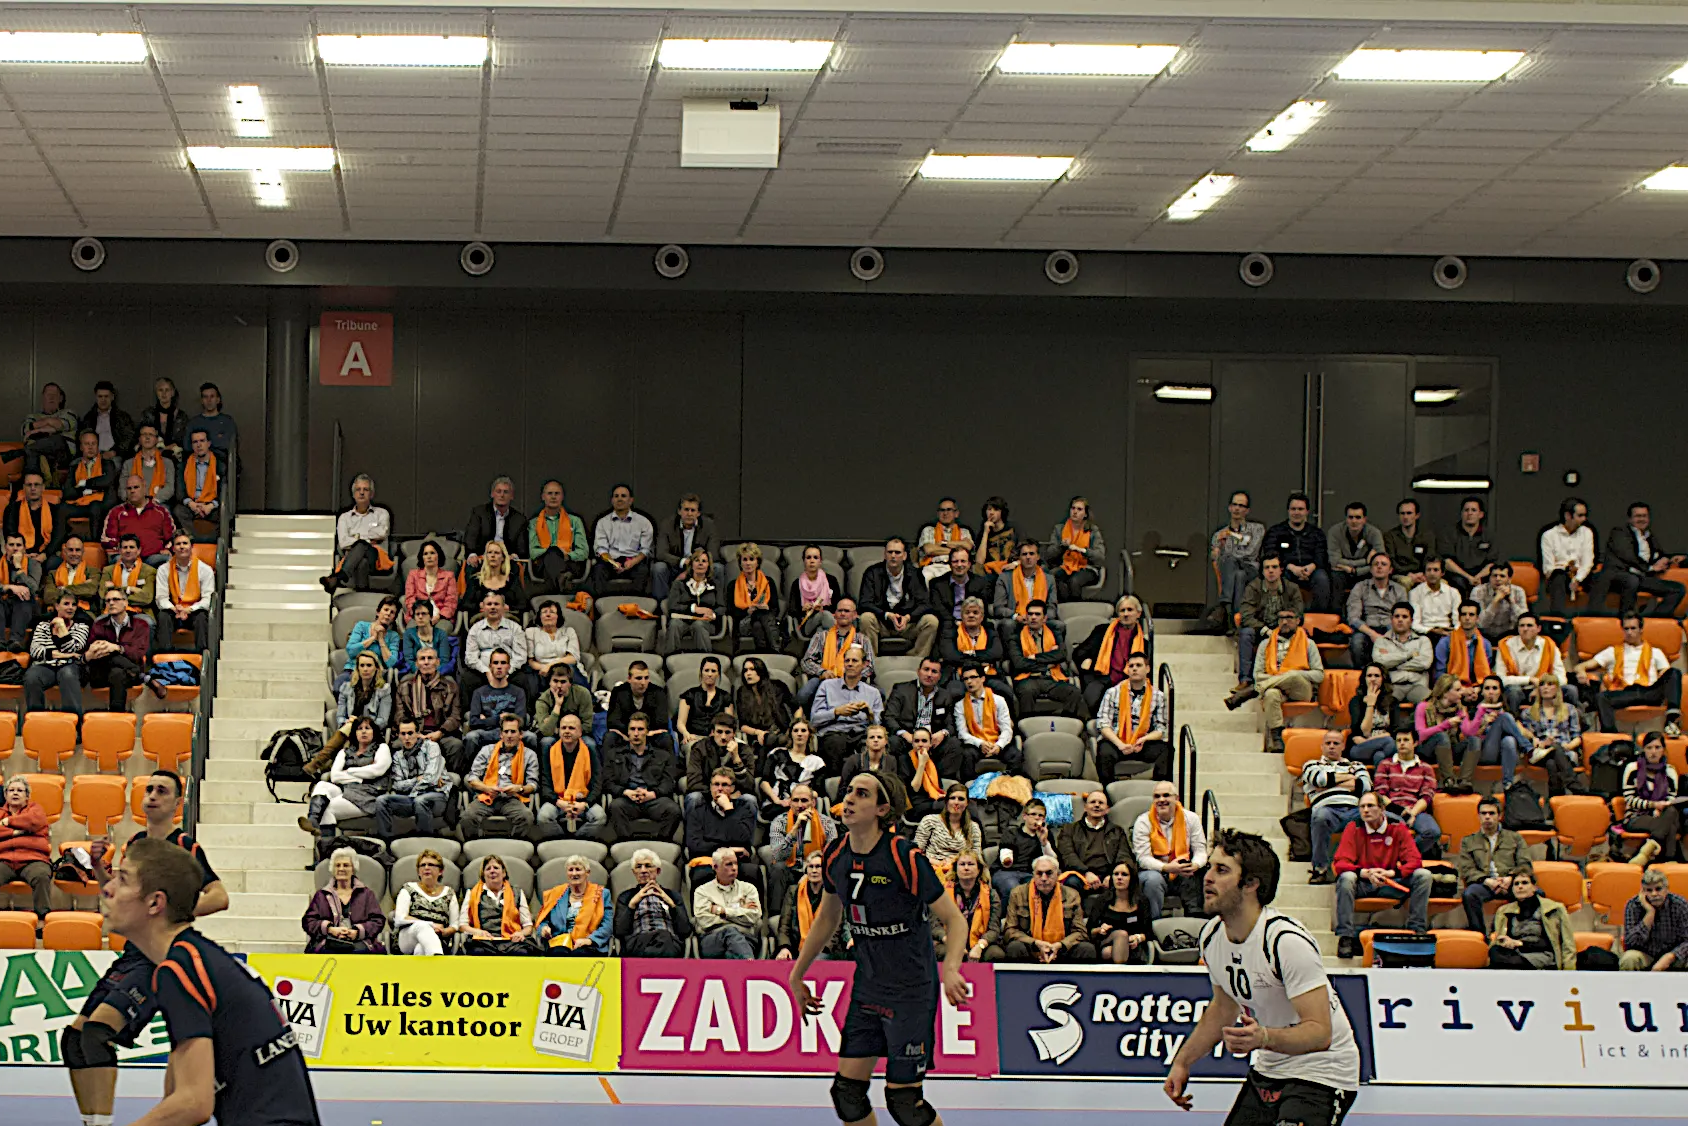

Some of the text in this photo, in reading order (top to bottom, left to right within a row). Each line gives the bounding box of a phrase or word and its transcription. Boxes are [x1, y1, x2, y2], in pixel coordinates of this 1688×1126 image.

[335, 320, 378, 331] Tribune
[340, 341, 372, 376] A
[850, 873, 865, 899] 7
[357, 982, 509, 1009] Alles voor
[1226, 965, 1252, 1000] 10
[542, 1001, 587, 1031] IVA
[1092, 993, 1210, 1023] Rotter
[345, 1012, 522, 1038] Uw kantoor
[539, 1031, 584, 1049] GROEP
[1598, 1044, 1688, 1058] ict & inf
